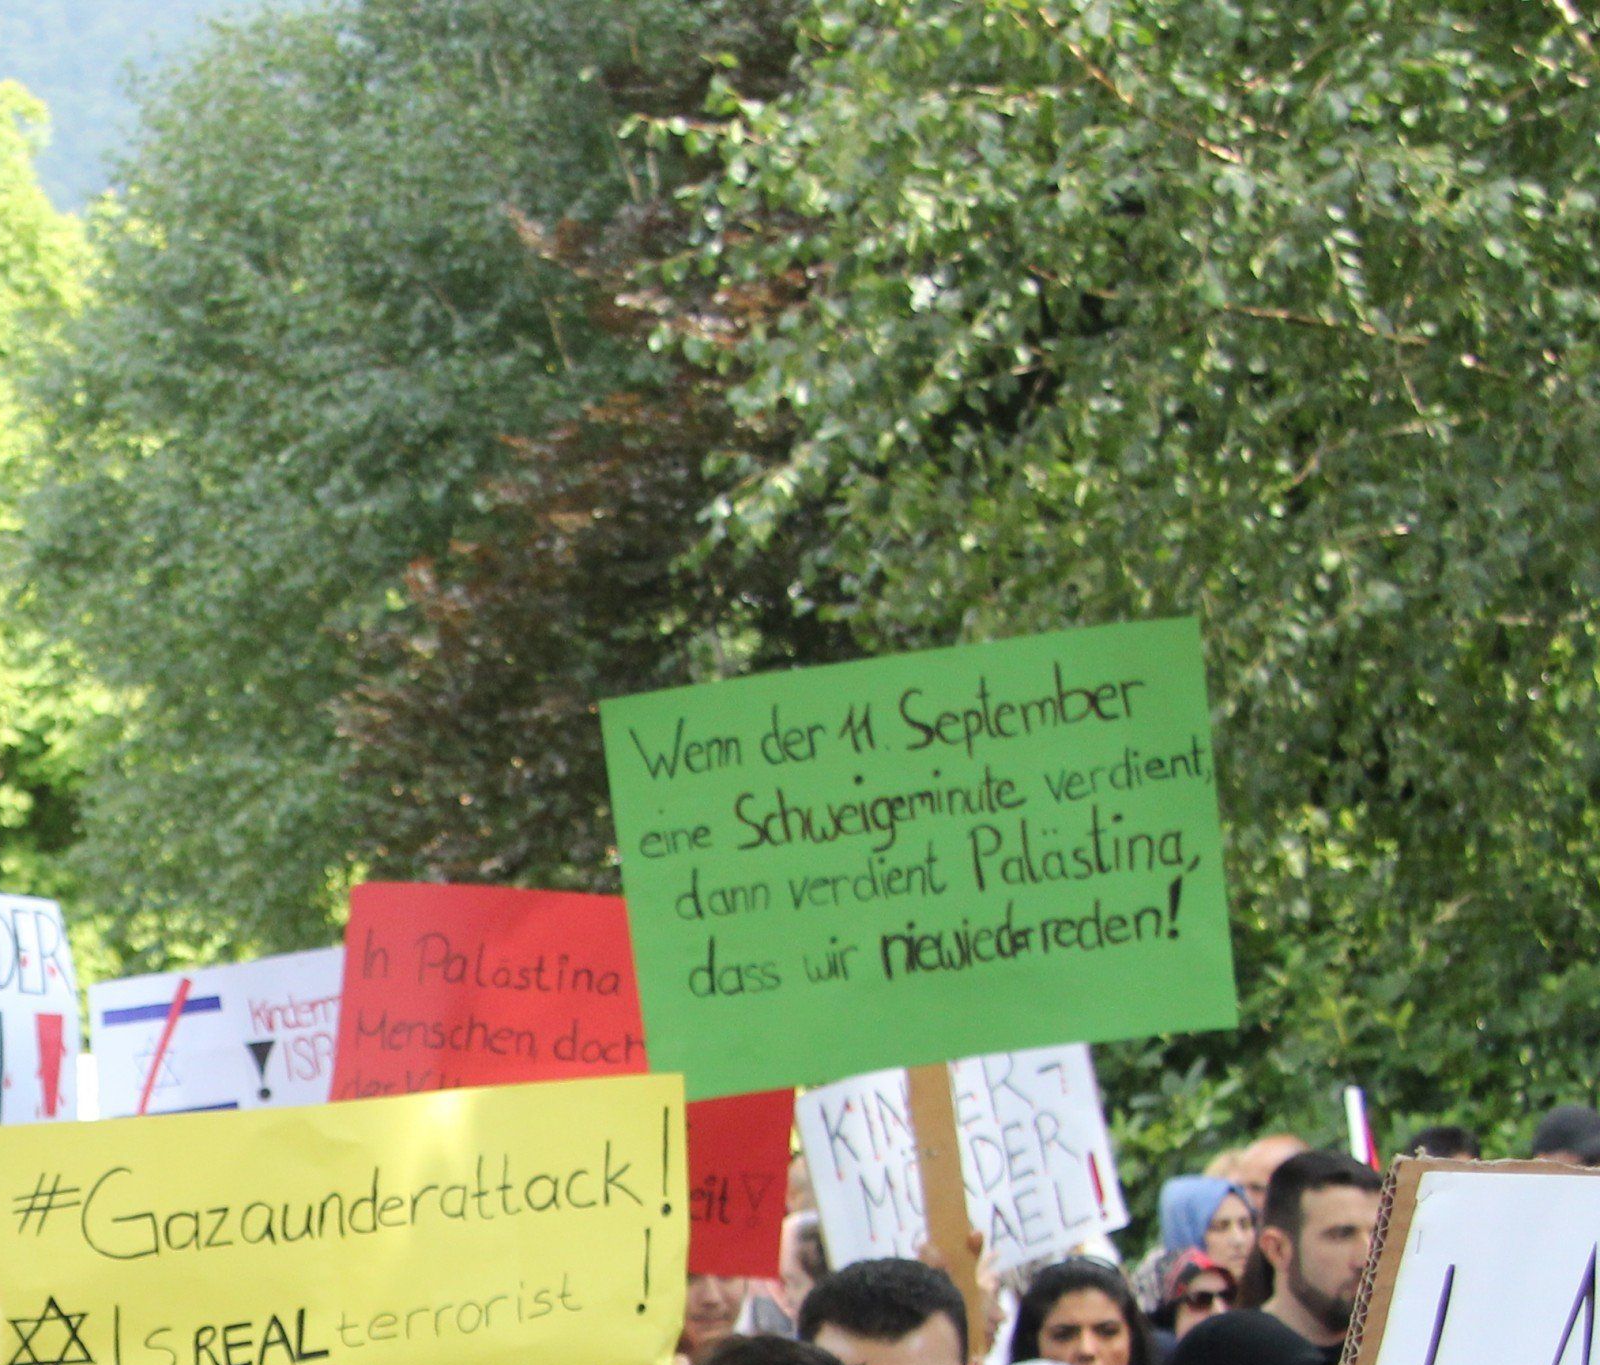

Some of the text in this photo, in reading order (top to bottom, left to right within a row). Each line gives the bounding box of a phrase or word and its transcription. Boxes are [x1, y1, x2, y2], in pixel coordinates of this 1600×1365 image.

[629, 716, 742, 781] Wenn
[761, 704, 824, 767] der
[899, 661, 1145, 757] September
[638, 808, 712, 860] eine
[735, 769, 1027, 854] Schweigeminute
[675, 803, 1201, 920] dann verdient Palästina,
[689, 936, 782, 1000] dass
[804, 935, 859, 986] wir
[355, 1012, 538, 1062] Menschen
[336, 1273, 583, 1349] terrorist
